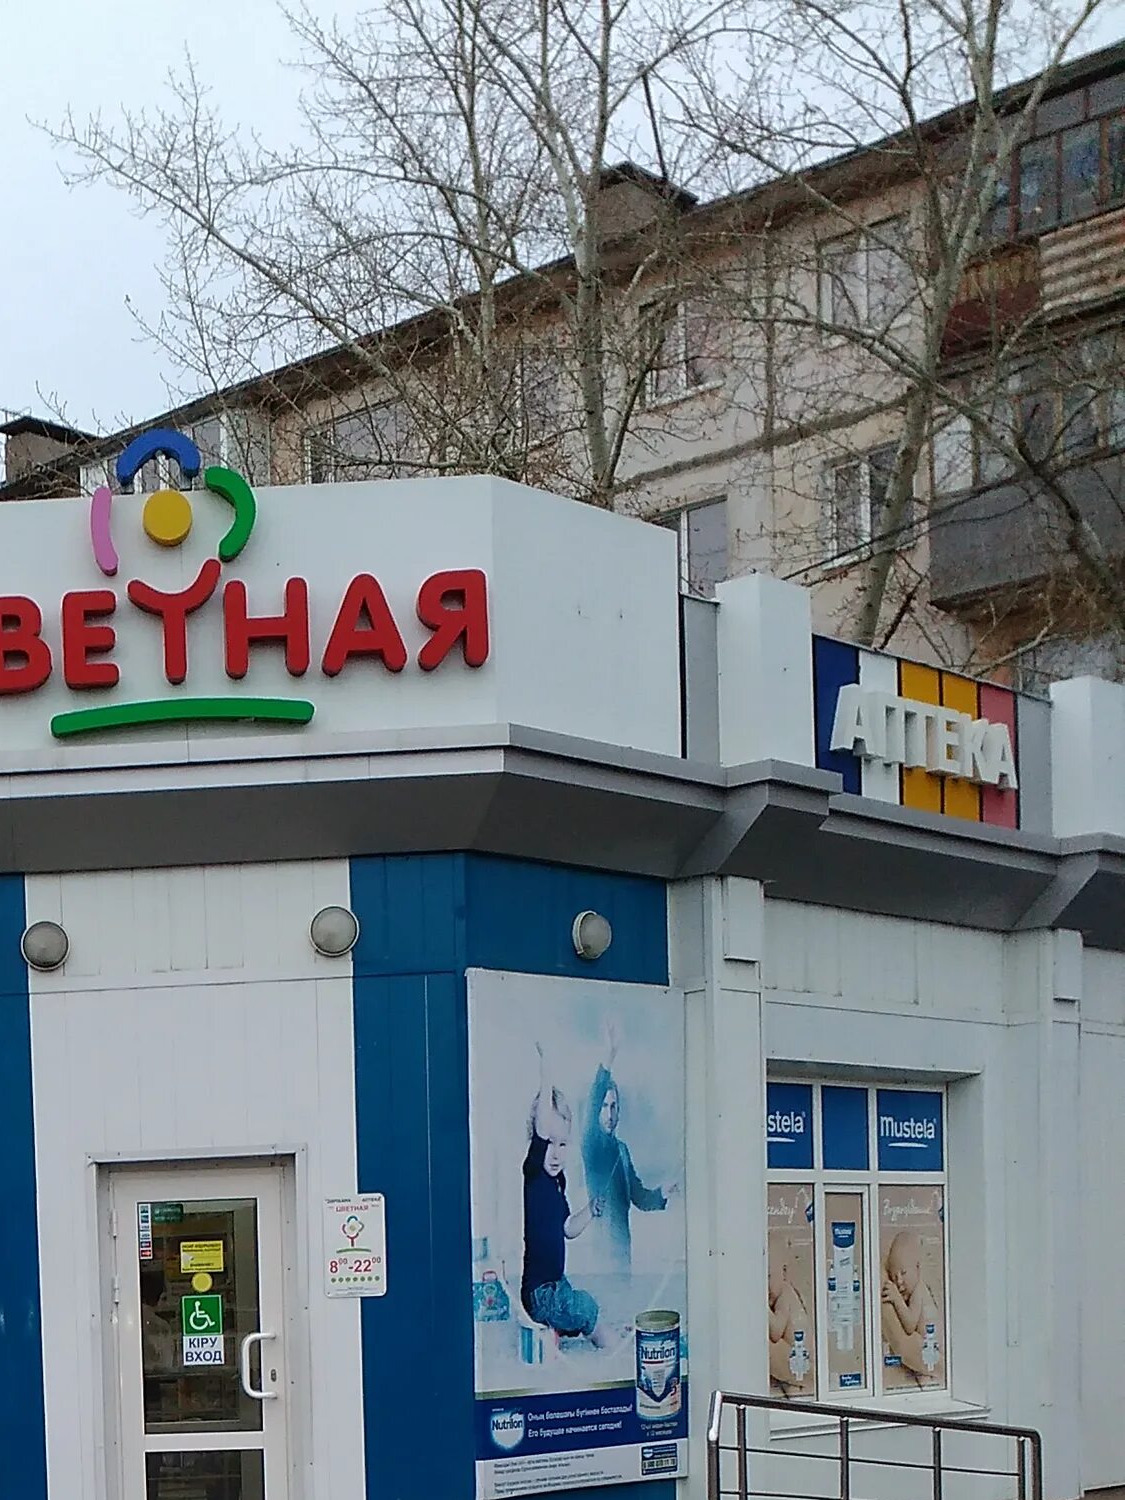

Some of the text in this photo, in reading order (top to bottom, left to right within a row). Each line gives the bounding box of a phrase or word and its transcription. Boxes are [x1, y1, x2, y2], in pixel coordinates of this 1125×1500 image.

[830, 683, 1018, 789] АПТЕКА
[188, 1337, 218, 1348] КІРУ
[185, 1350, 223, 1363] ВХОД
[491, 1418, 523, 1431] Nutrilon
